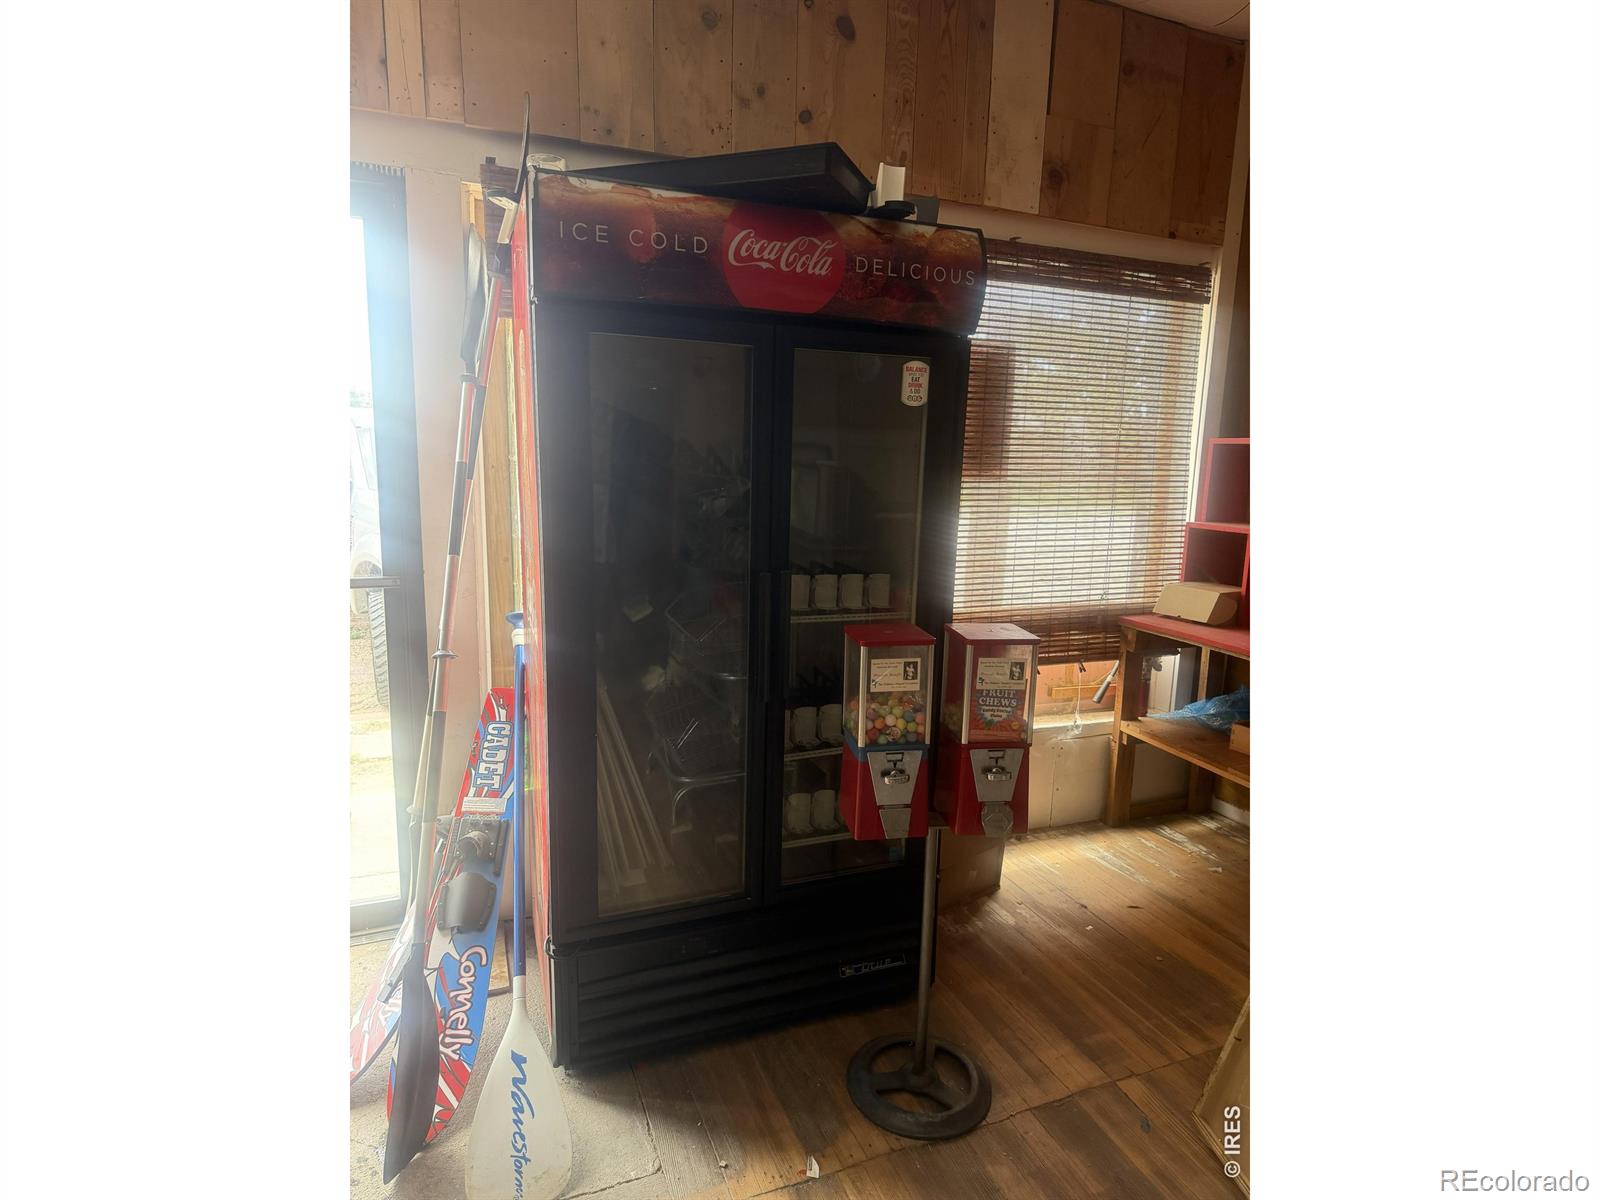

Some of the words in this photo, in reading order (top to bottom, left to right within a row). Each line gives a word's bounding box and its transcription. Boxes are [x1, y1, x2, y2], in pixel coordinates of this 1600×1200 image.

[559, 220, 610, 244] ICE
[629, 230, 709, 255] COLD
[727, 228, 835, 277] Coca-Cola
[855, 255, 976, 287] DELICIOUS
[905, 365, 928, 373] BALANCE
[978, 696, 1017, 707] CHEWS
[982, 688, 1016, 698] FRUIT
[476, 722, 513, 790] CADET
[438, 946, 489, 1061] Connelly
